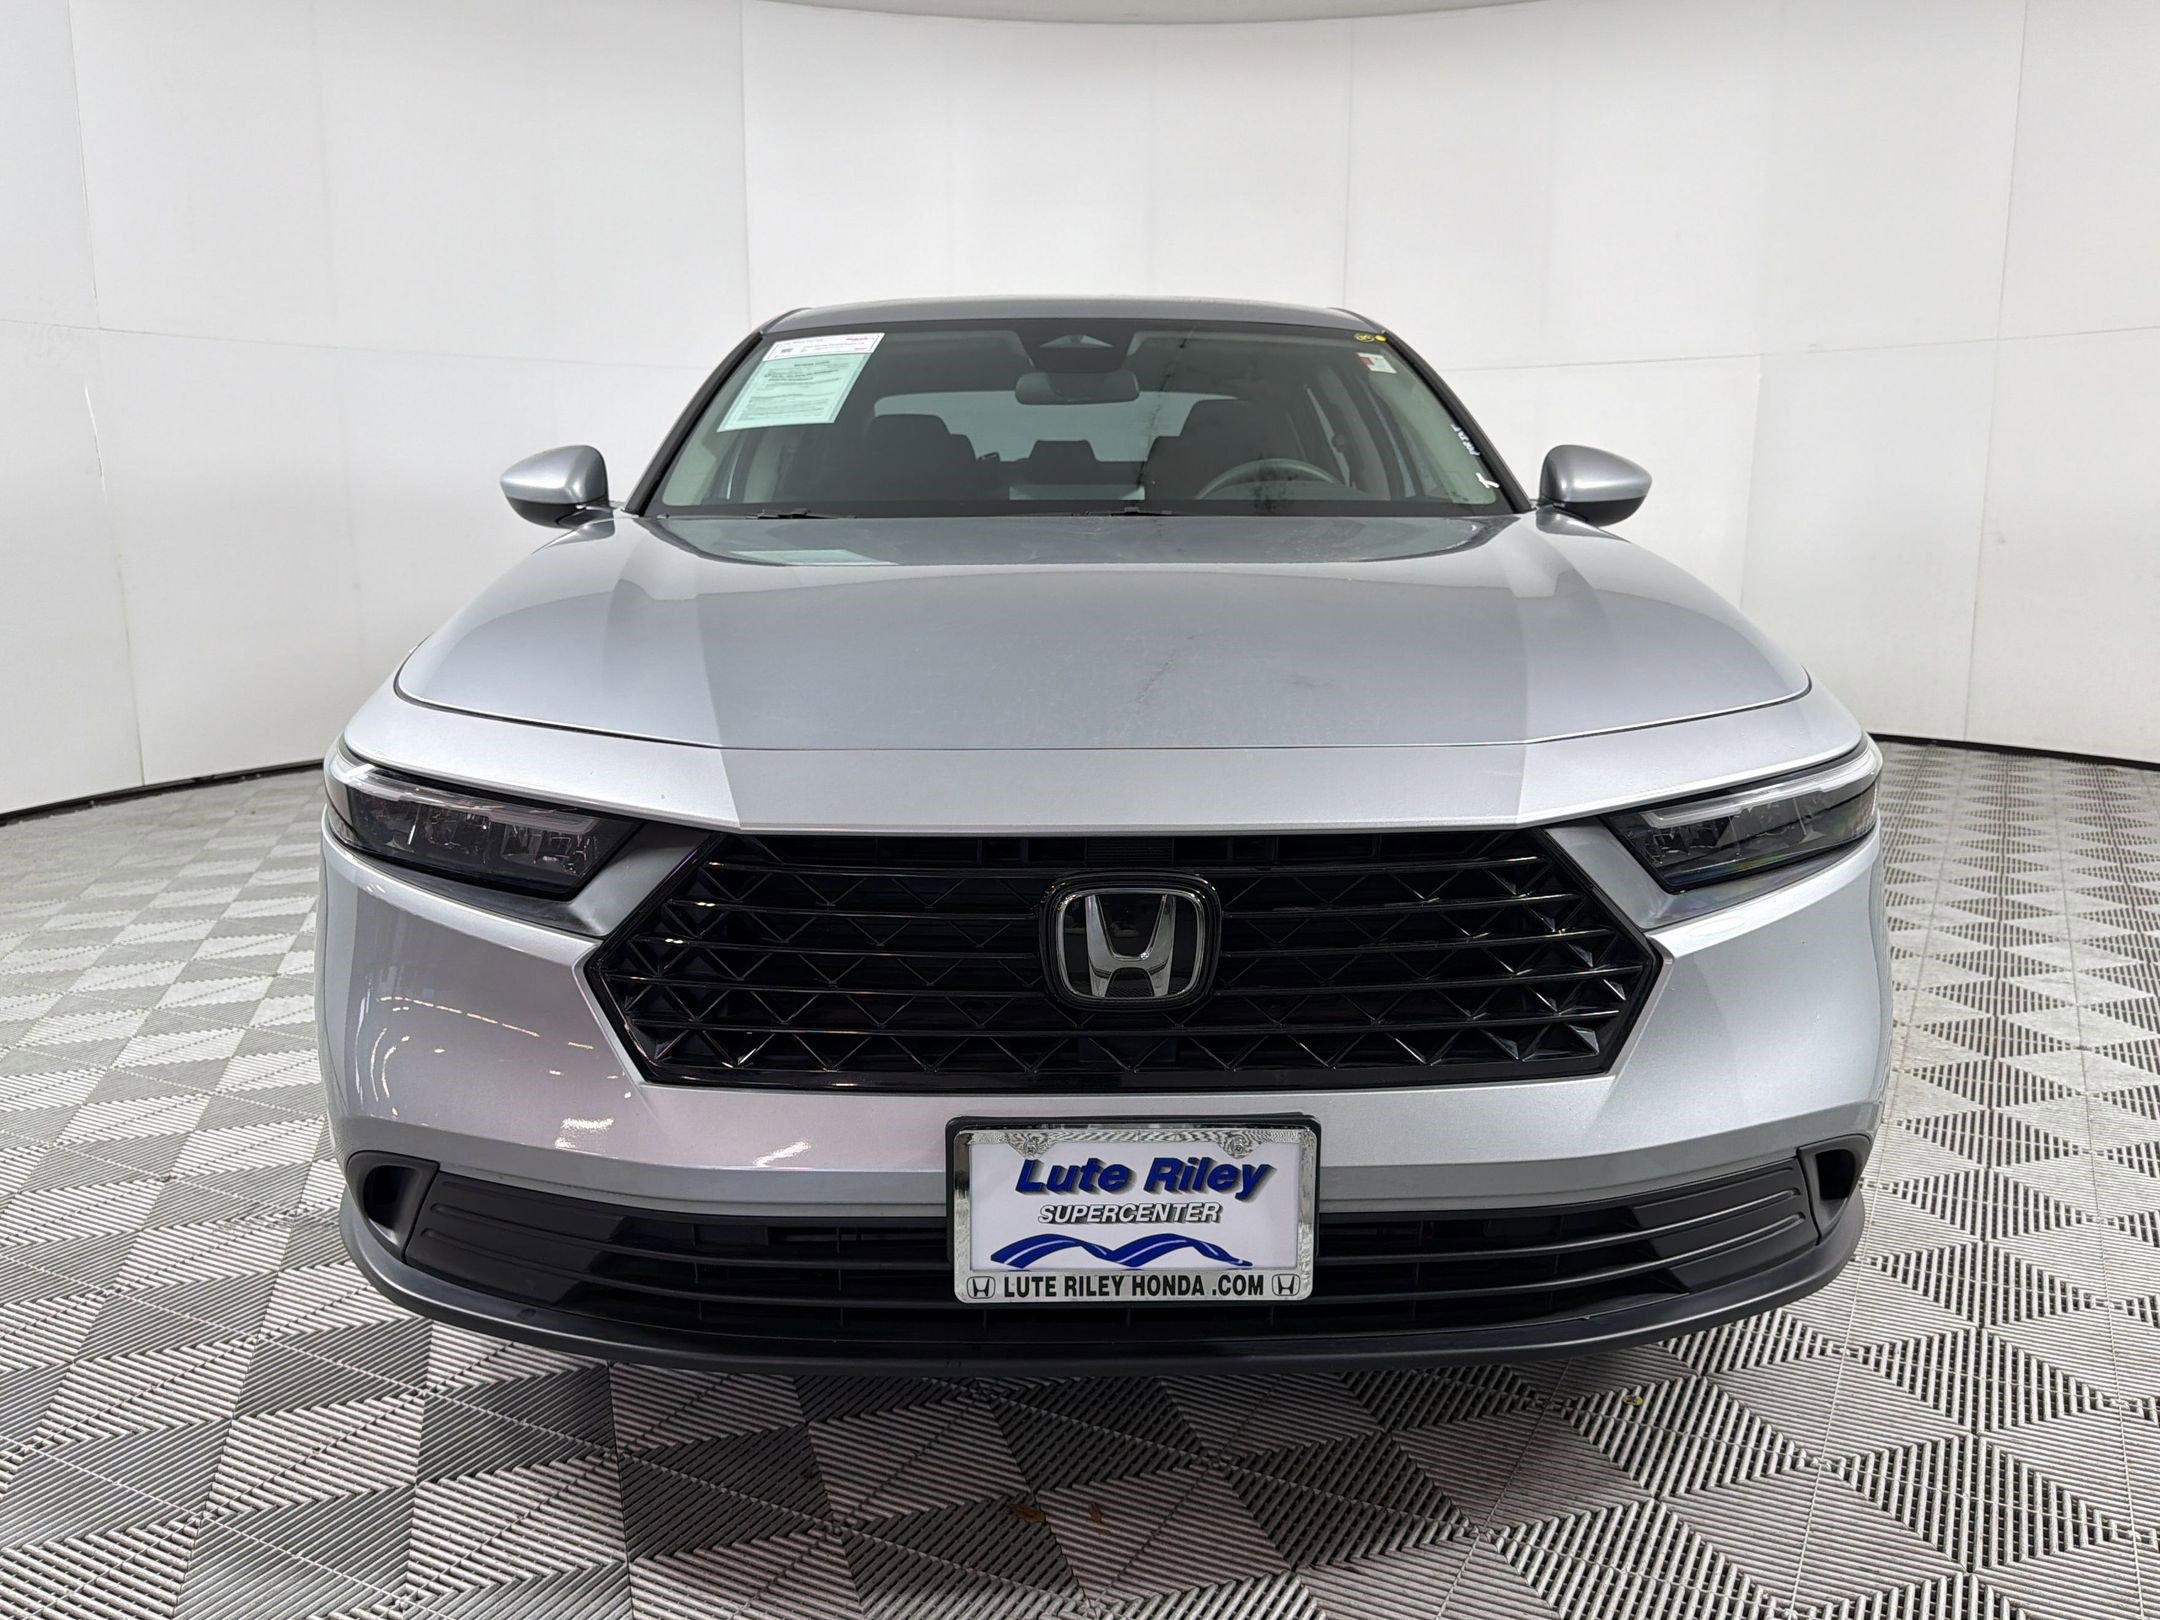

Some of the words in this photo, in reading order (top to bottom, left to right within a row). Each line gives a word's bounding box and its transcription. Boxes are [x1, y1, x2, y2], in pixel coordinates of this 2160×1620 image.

[1015, 1158, 1134, 1195] Lute
[1143, 1157, 1277, 1202] Riley
[1038, 1201, 1224, 1225] SUPERCENTER
[1003, 1276, 1057, 1298] LUTE
[1064, 1275, 1128, 1298] RILEY
[1131, 1274, 1205, 1297] HONDA
